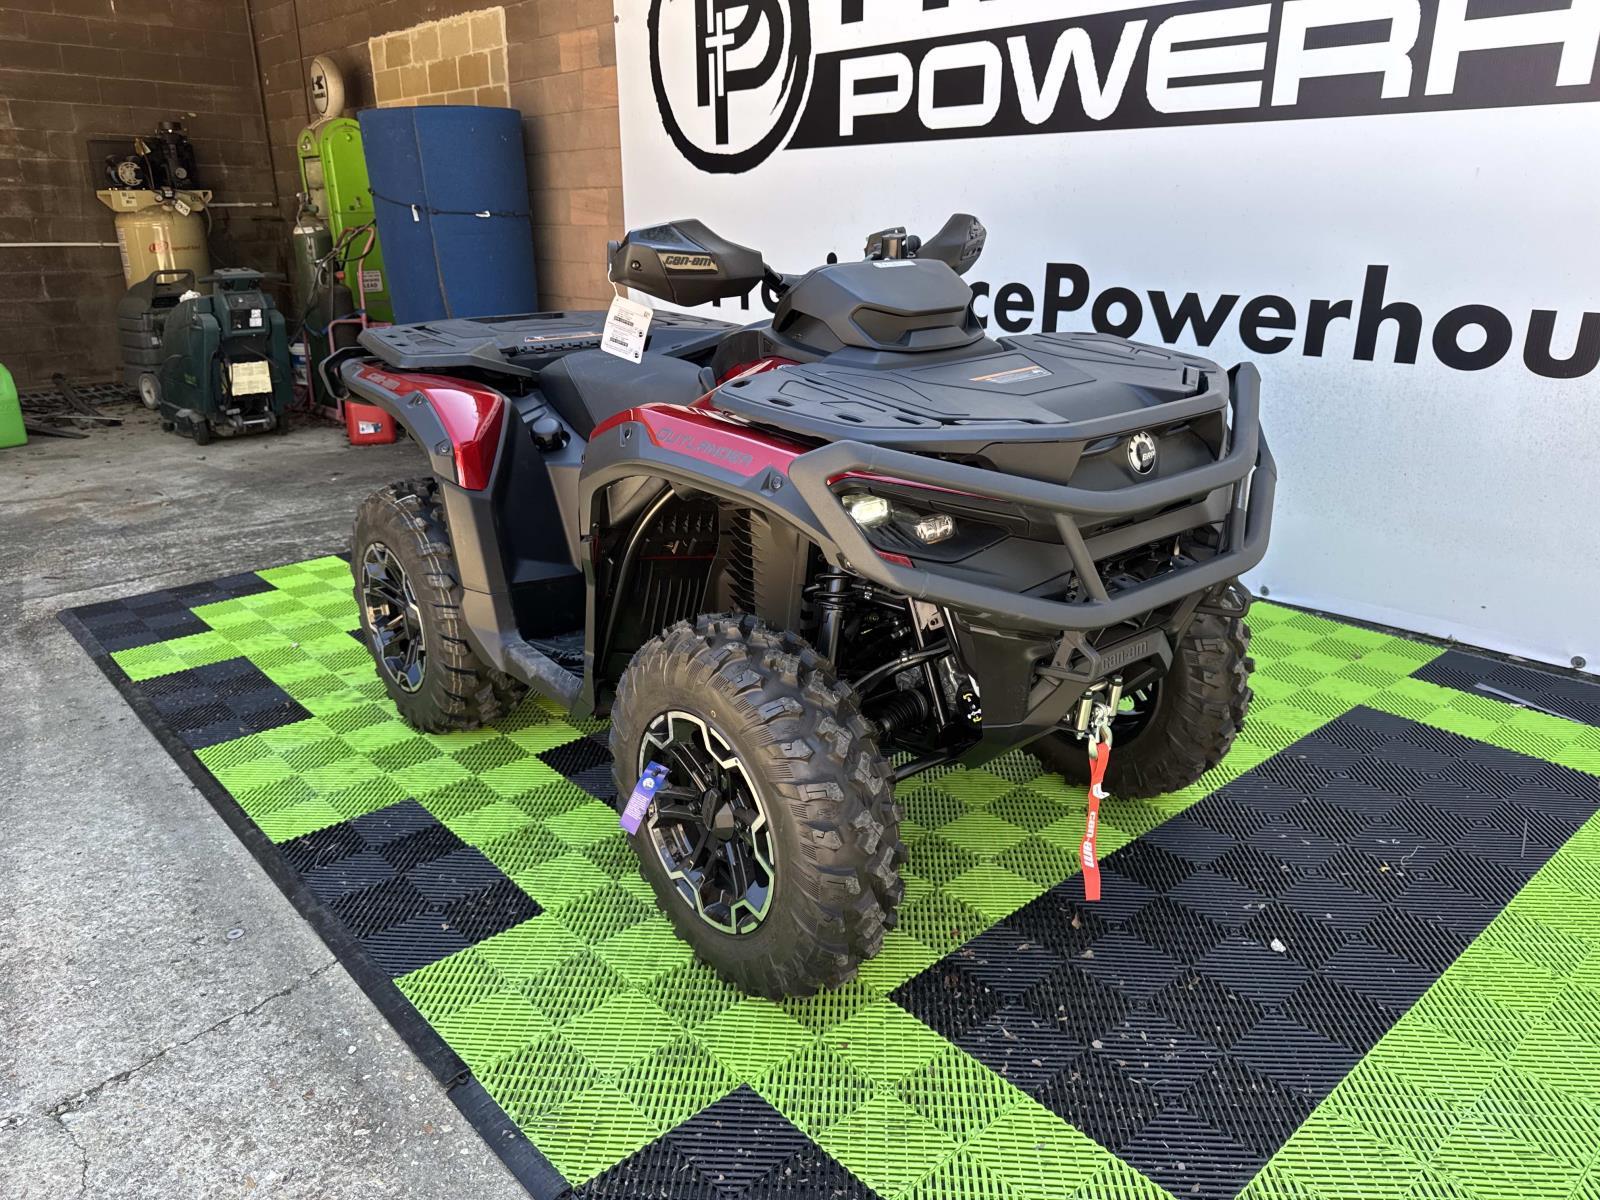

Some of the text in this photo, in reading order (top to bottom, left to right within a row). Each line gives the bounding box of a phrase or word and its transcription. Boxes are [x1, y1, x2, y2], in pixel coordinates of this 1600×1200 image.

[665, 255, 713, 266] can-am
[657, 428, 753, 467] OUTLANDER
[1083, 811, 1097, 868] can-am
